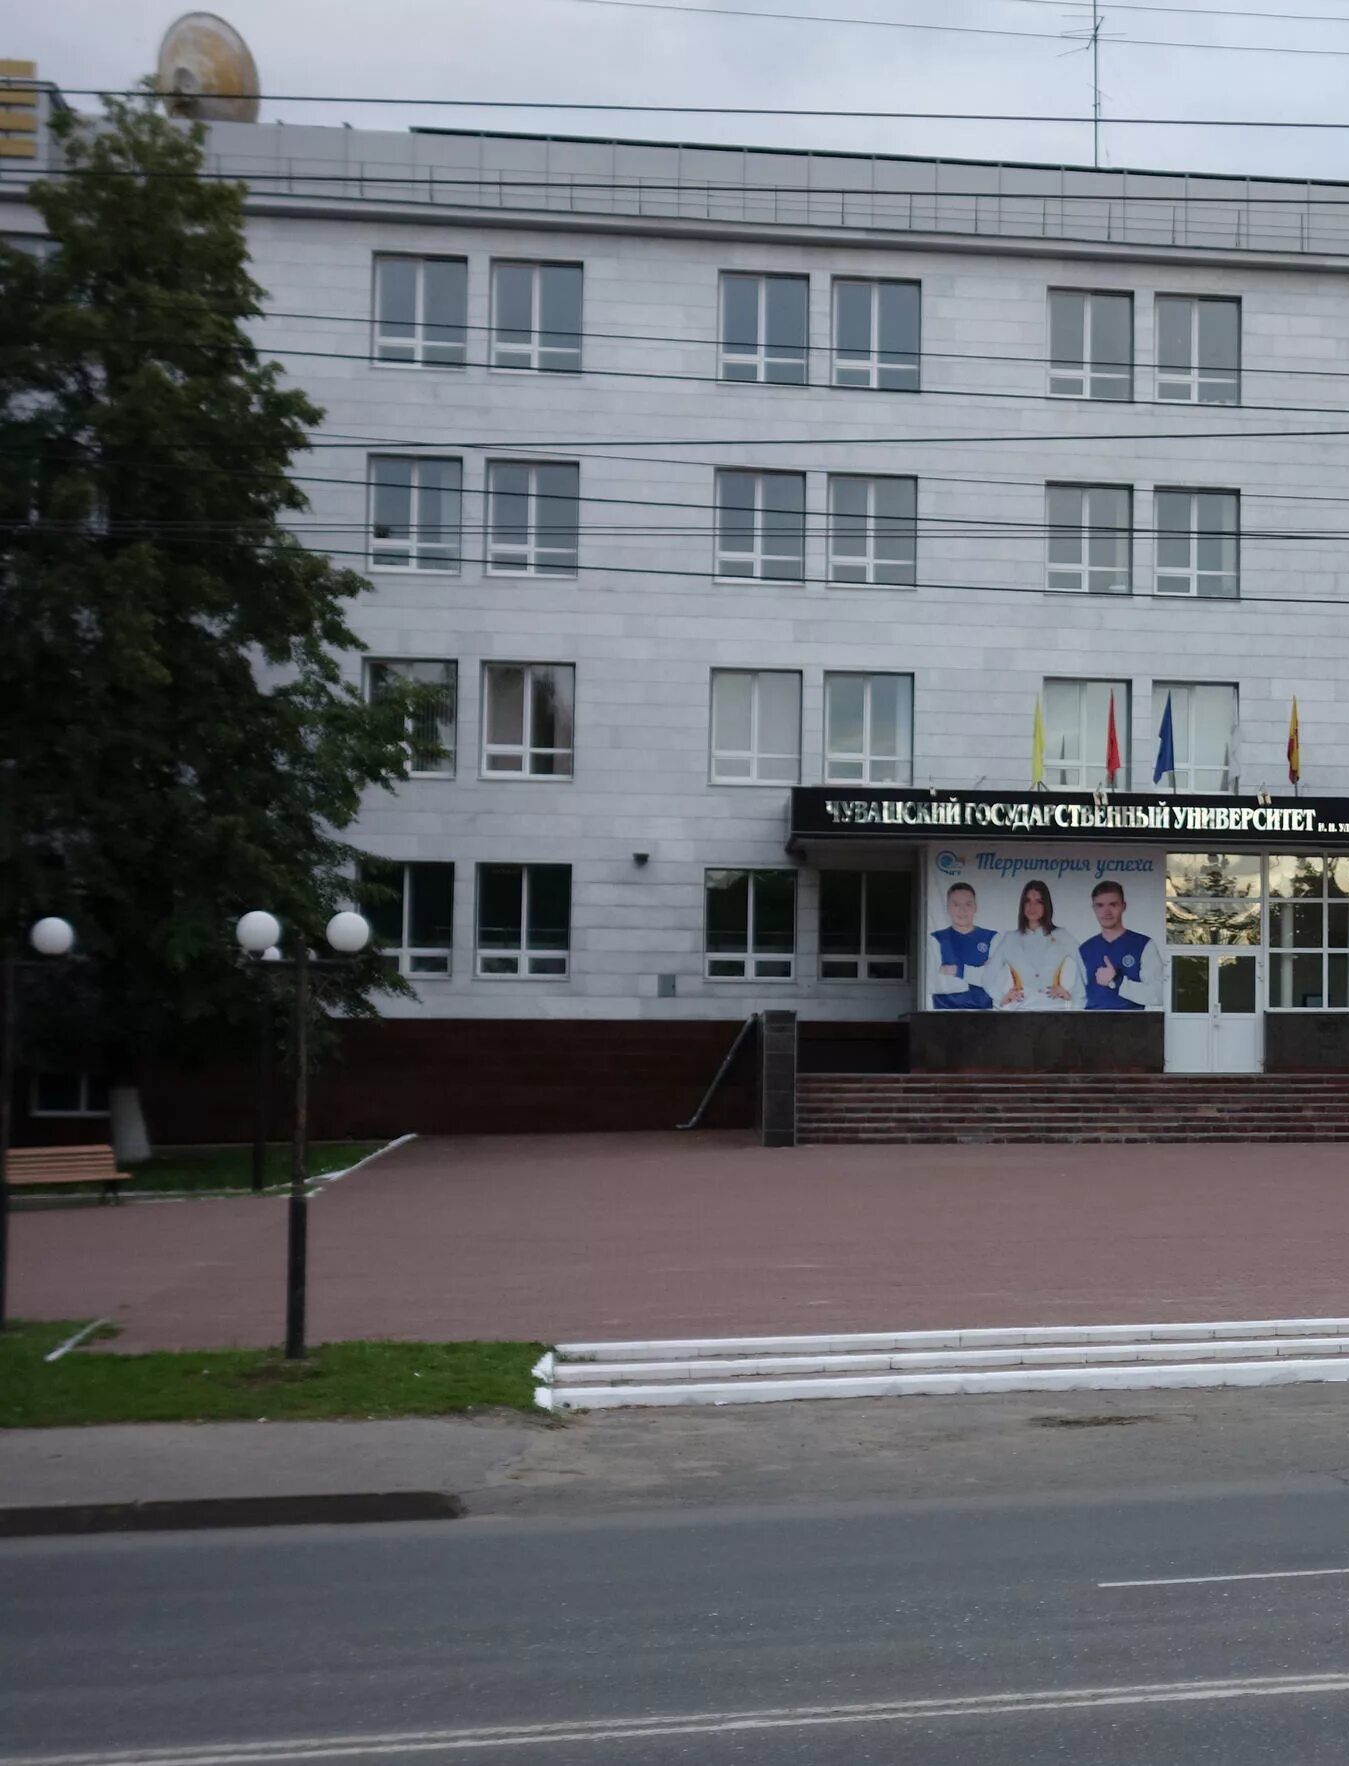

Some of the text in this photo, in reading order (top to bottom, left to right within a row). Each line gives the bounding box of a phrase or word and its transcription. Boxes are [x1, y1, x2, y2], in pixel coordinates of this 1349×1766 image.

[825, 797, 1316, 831] ЧУВАШСКИЙ ГОСУДАРСТВЕННЫЙ УНИВЕРСИТЕТ
[976, 852, 1154, 878] Территория успеха
